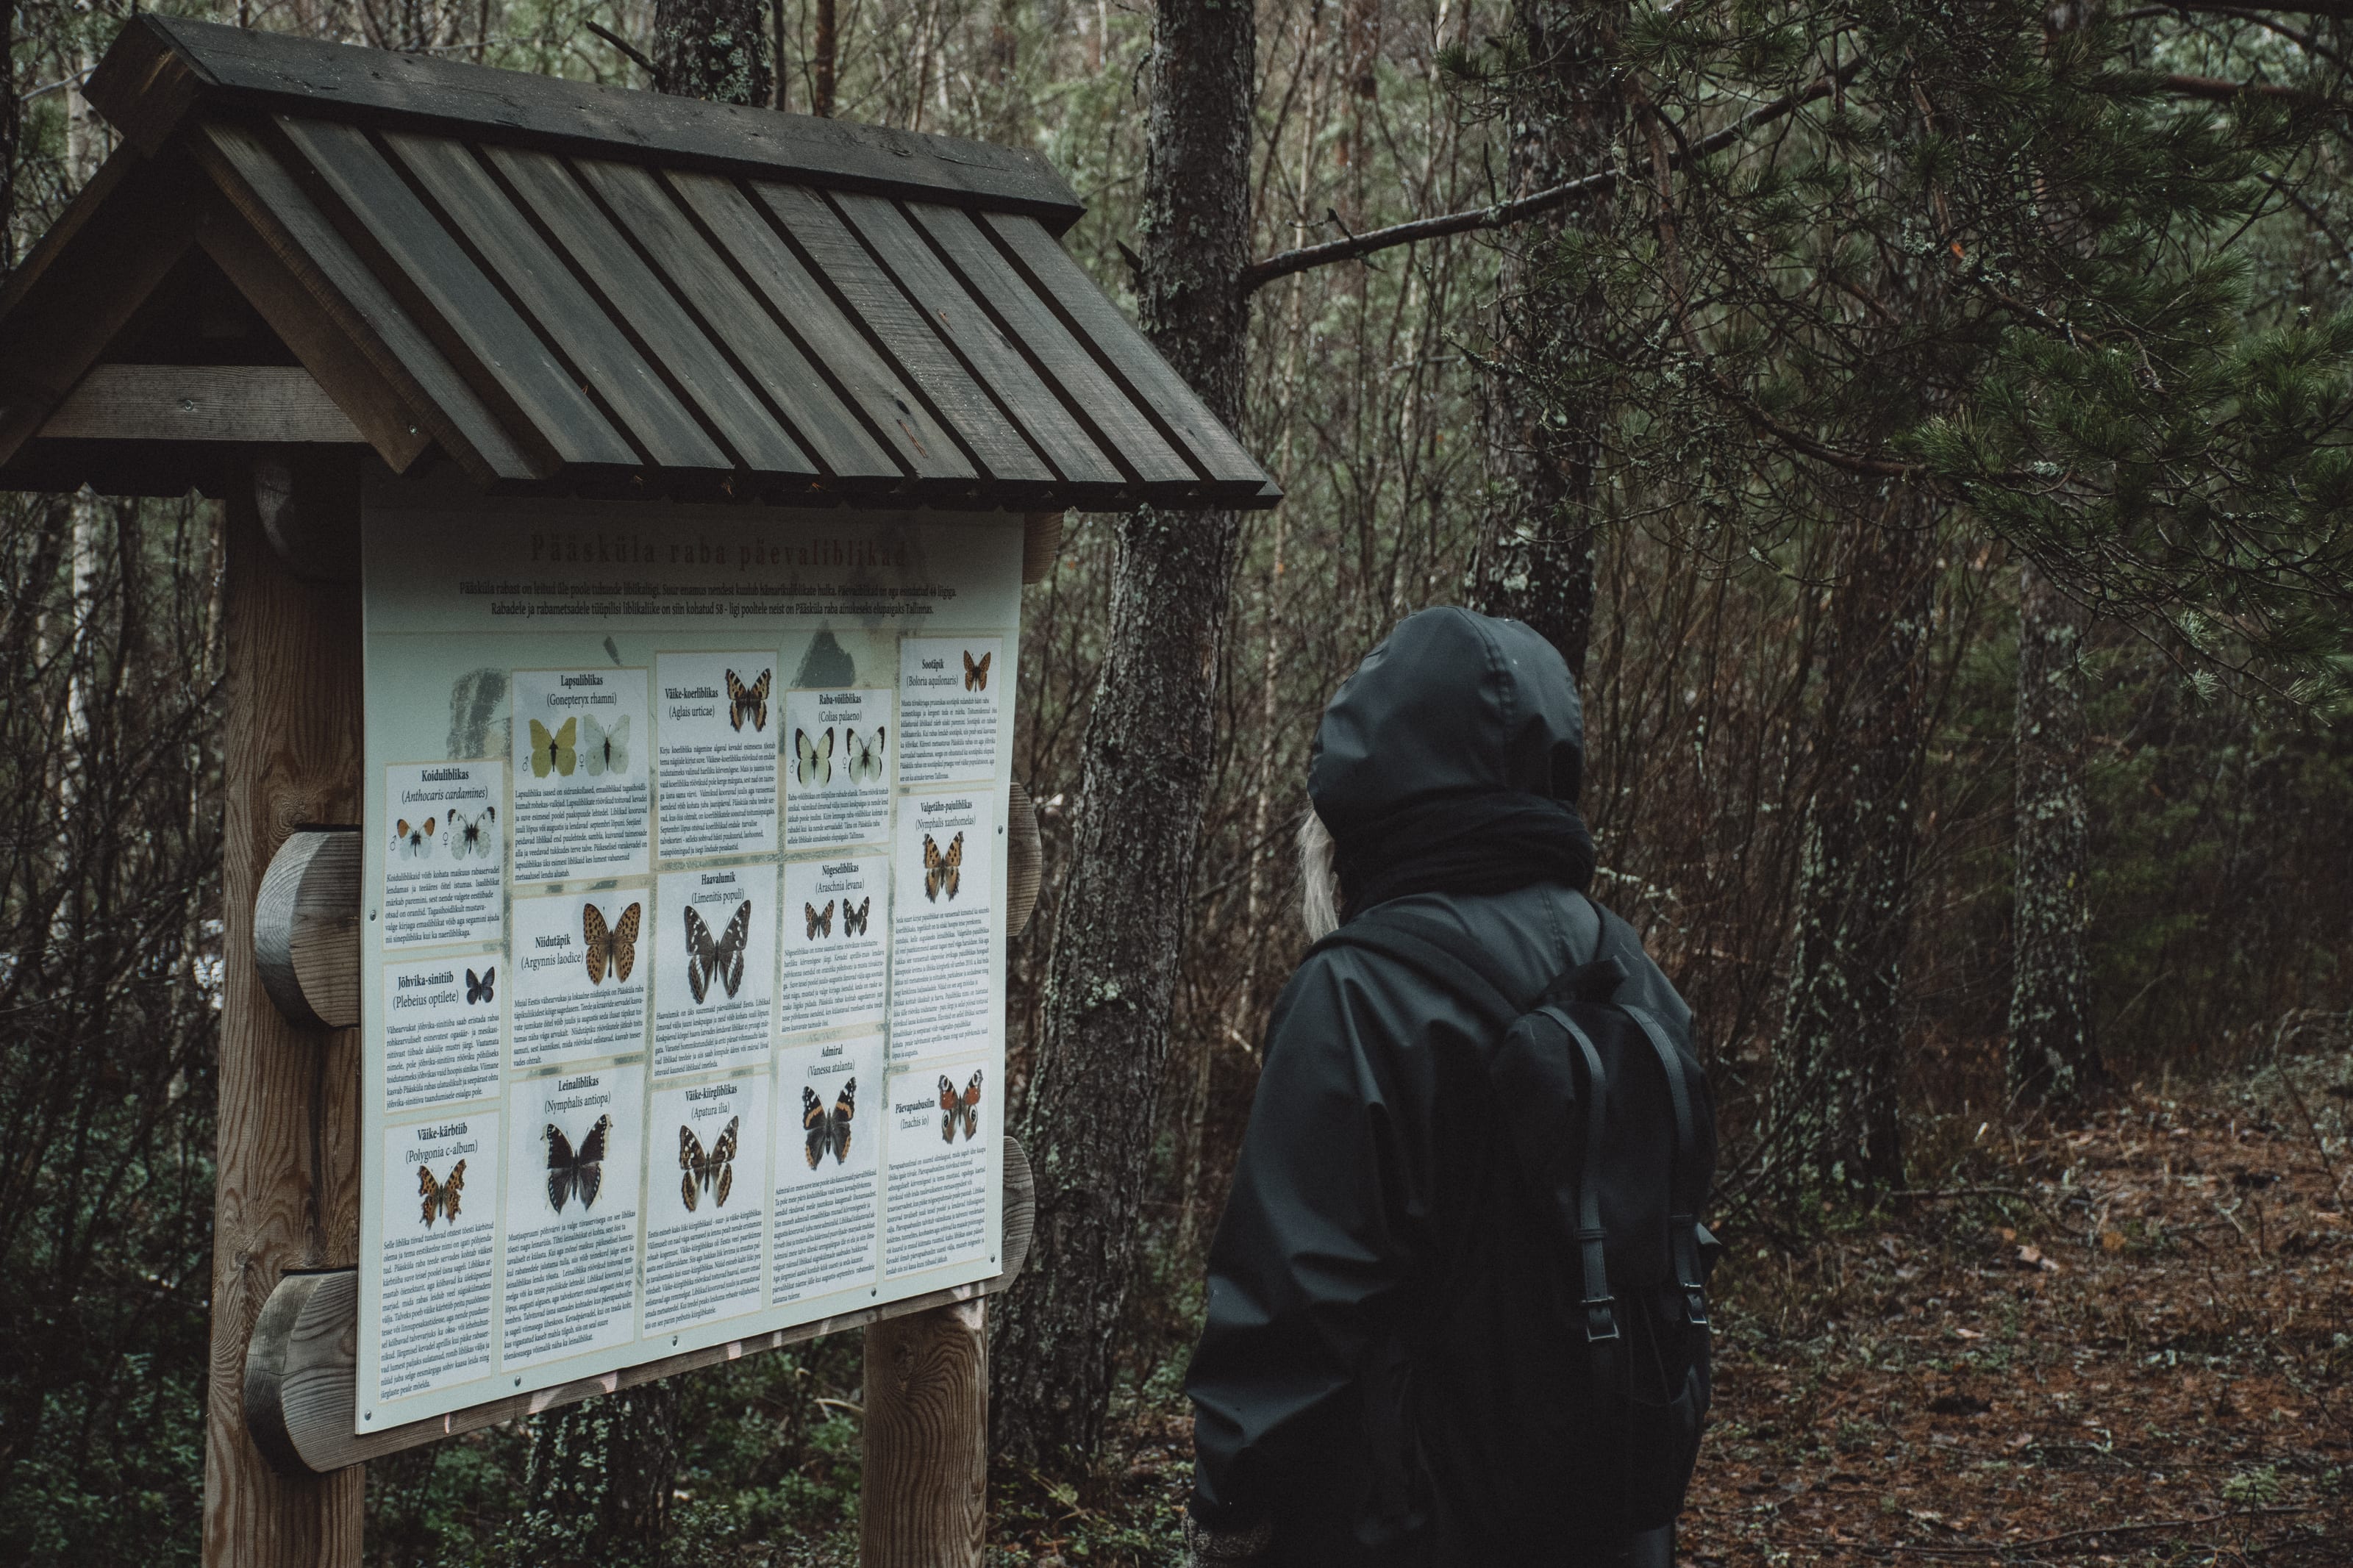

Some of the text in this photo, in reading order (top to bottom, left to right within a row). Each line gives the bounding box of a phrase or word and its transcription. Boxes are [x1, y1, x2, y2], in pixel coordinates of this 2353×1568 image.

[671, 536, 726, 565] raba
[739, 538, 906, 572] päevaliblikad
[491, 601, 526, 614] Rabadele
[527, 601, 535, 617] ja
[536, 601, 590, 614] rabametsadele
[591, 601, 621, 617] tüüpilisi
[623, 601, 660, 614] liblikaliike
[662, 606, 671, 614] on
[672, 601, 685, 614] siin
[687, 601, 714, 614] kohatud
[715, 601, 724, 614] 58
[729, 601, 740, 617] ligi
[741, 601, 766, 617] pooltele
[768, 601, 785, 614] neist
[786, 606, 794, 614] on
[795, 601, 823, 614] Pääsküla
[824, 601, 838, 614] raba
[839, 601, 872, 614] ainukeseks
[874, 601, 904, 617] elupaigaks
[905, 601, 933, 614] Tallinnas.
[921, 659, 944, 672] Sootäpik
[560, 674, 604, 690] Lapsuliblikas
[907, 674, 958, 689] (Boloria aquilonaris)
[547, 691, 617, 708] (Gonepteryx rhamni)
[665, 687, 718, 699] Väike-koerliblikas
[819, 693, 862, 705] Raba-võiliblikas
[669, 705, 715, 720] (Aglais urticae)
[818, 709, 862, 725] (Colias palaeno)
[421, 768, 469, 781] Koiduliblikas
[402, 785, 488, 804] (Anthocaris cardamines)
[915, 814, 976, 832] (Nymphalis xanthomelas)
[701, 871, 735, 885] Haavalumik
[815, 878, 864, 895] (Araschnia levana)
[691, 887, 744, 906] (Limenitis populi)
[385, 910, 398, 918] otsad
[385, 923, 397, 932] valge
[399, 922, 415, 931] kirjaga
[535, 934, 571, 949] Niidutäpik
[521, 951, 584, 970] (Argynnis laodice)
[398, 970, 454, 990] Jõhvika-sinitiib
[393, 989, 459, 1011] (Plebeius optilete)
[387, 1023, 416, 1034] Vähearvukat
[457, 1017, 466, 1026] saab
[468, 1015, 486, 1025] eristada
[488, 1014, 499, 1023] rabas
[471, 1028, 476, 1039] ja
[476, 1037, 499, 1047] Vaatamata
[821, 1044, 843, 1058] Admiral
[406, 1060, 416, 1072] pole
[807, 1059, 855, 1078] (Vanessa atalanta)
[558, 1075, 599, 1092] Leinaliblikas
[685, 1084, 737, 1101] Väike-kiirgliblikas
[545, 1090, 611, 1115] (Nymphalis antiopa)
[691, 1101, 730, 1120] (Apatura ilia)
[895, 1098, 935, 1114] Päevapaabusilm
[900, 1114, 929, 1131] (Inachis io)
[418, 1122, 468, 1141] Väike-kärbtiib
[406, 1139, 478, 1164] (Polygonia c-album)
